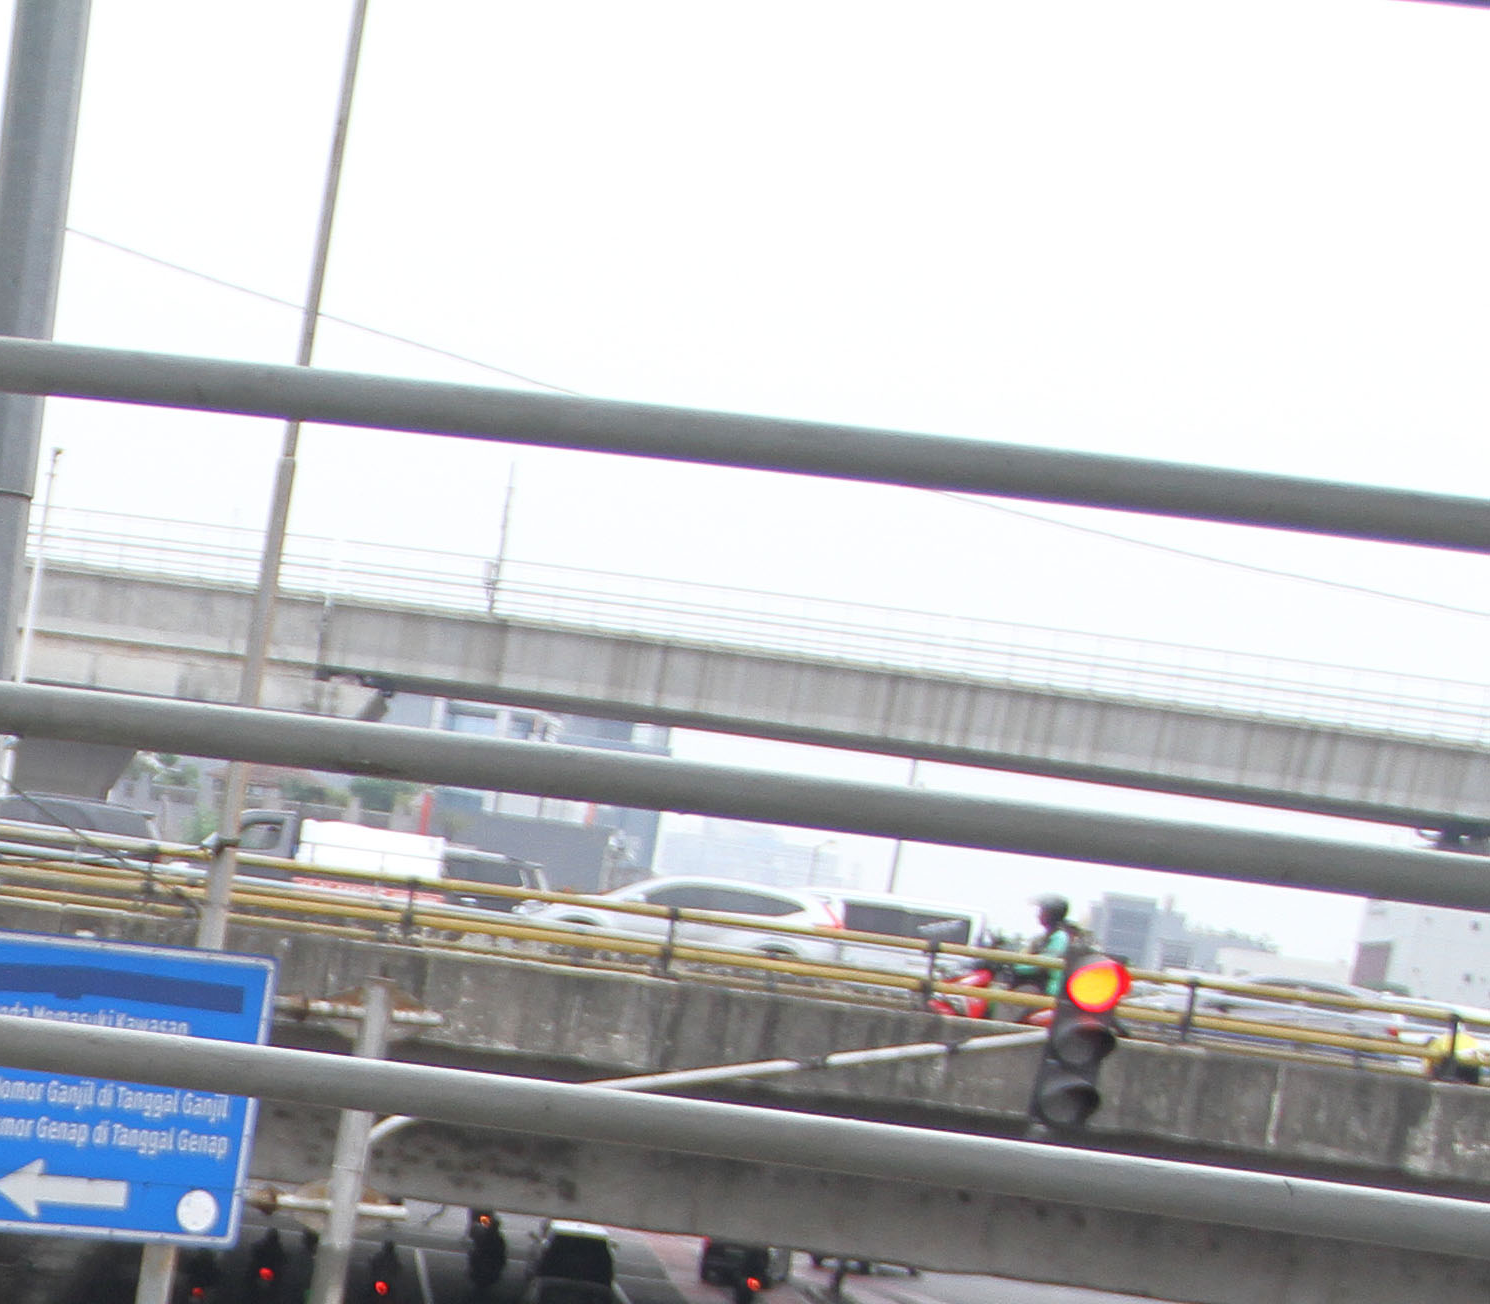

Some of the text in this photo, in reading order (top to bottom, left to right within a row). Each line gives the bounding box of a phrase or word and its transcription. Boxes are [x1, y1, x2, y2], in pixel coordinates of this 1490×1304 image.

[115, 1012, 189, 1036] Kawasan
[46, 1080, 96, 1111] Ganjil
[97, 1083, 115, 1108] di
[116, 1086, 180, 1118] Tanggal
[181, 1091, 230, 1124] Ganjil
[36, 1115, 90, 1148] Genap
[91, 1120, 110, 1145] di
[111, 1123, 176, 1156] Tanggal
[177, 1128, 231, 1160] Genap
